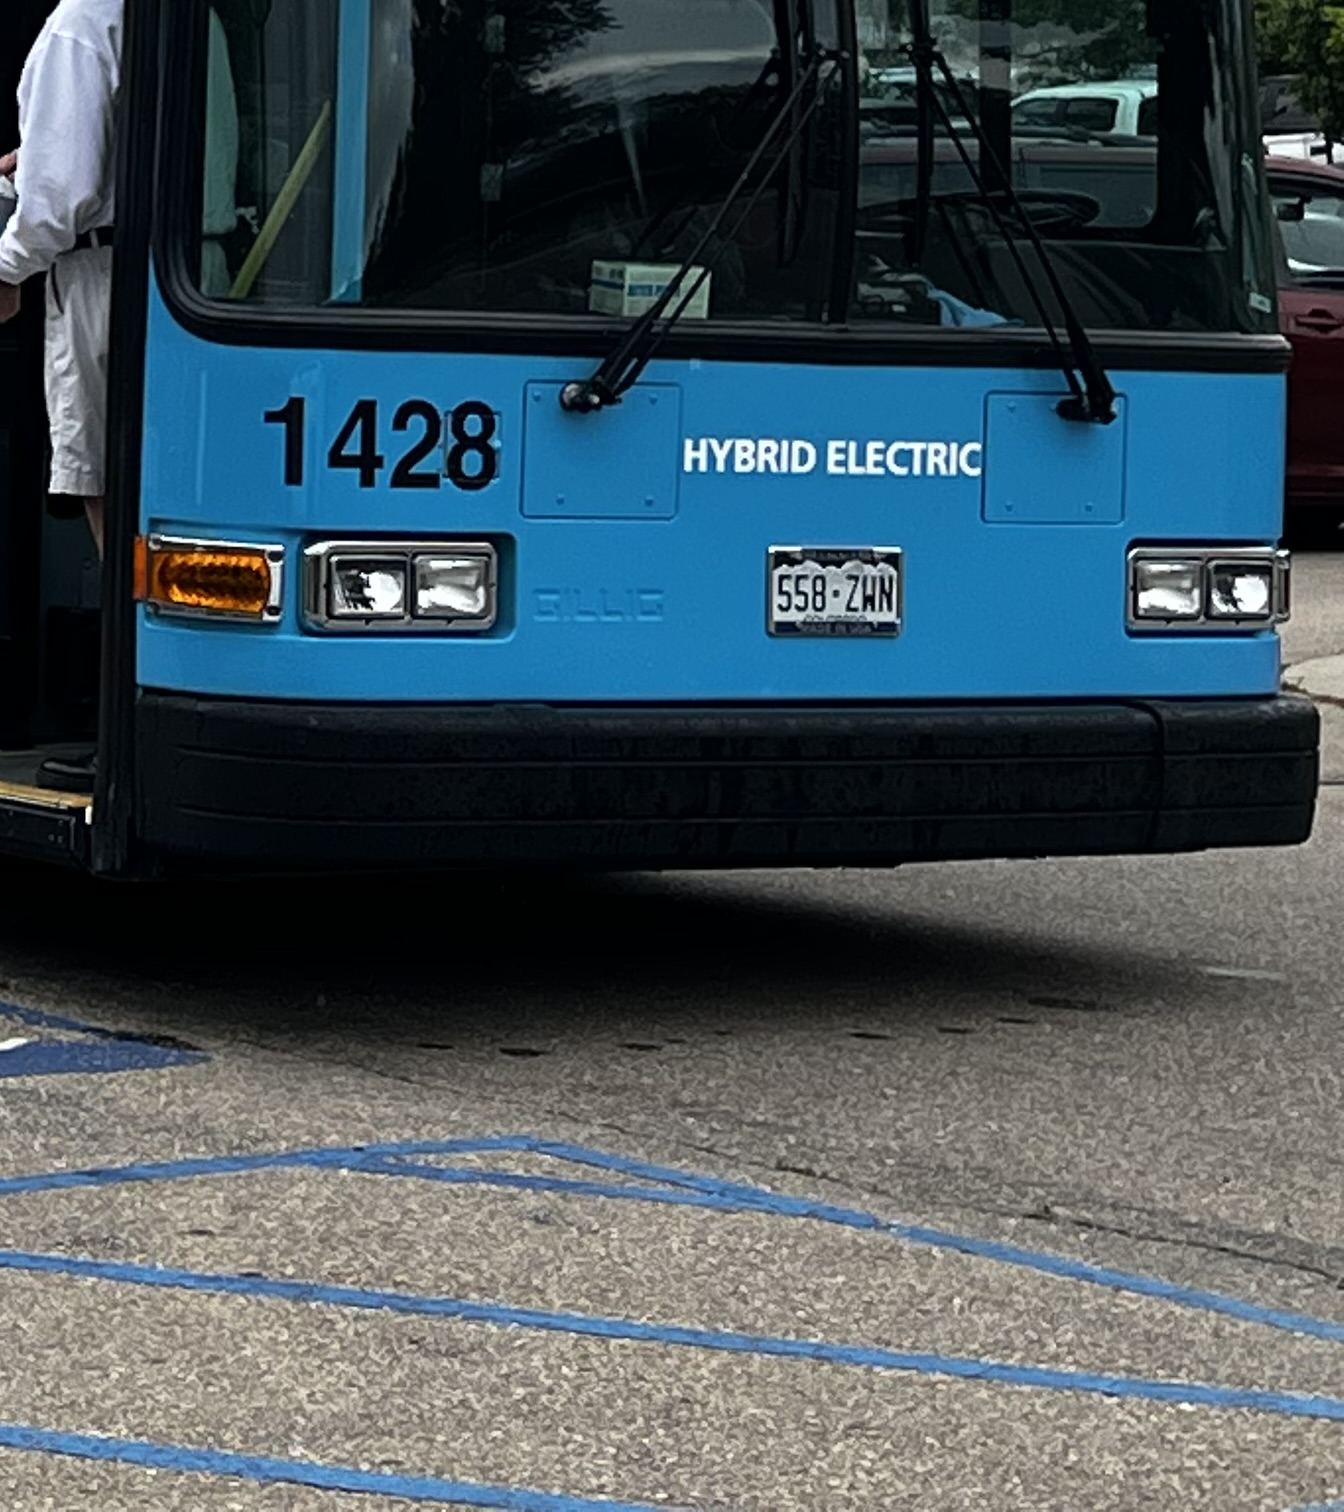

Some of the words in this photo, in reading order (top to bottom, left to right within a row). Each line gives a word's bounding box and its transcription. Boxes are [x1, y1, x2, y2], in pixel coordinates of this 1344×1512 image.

[264, 397, 498, 491] 1428
[683, 437, 817, 474] HYBRID
[826, 439, 983, 477] ELECTRIC
